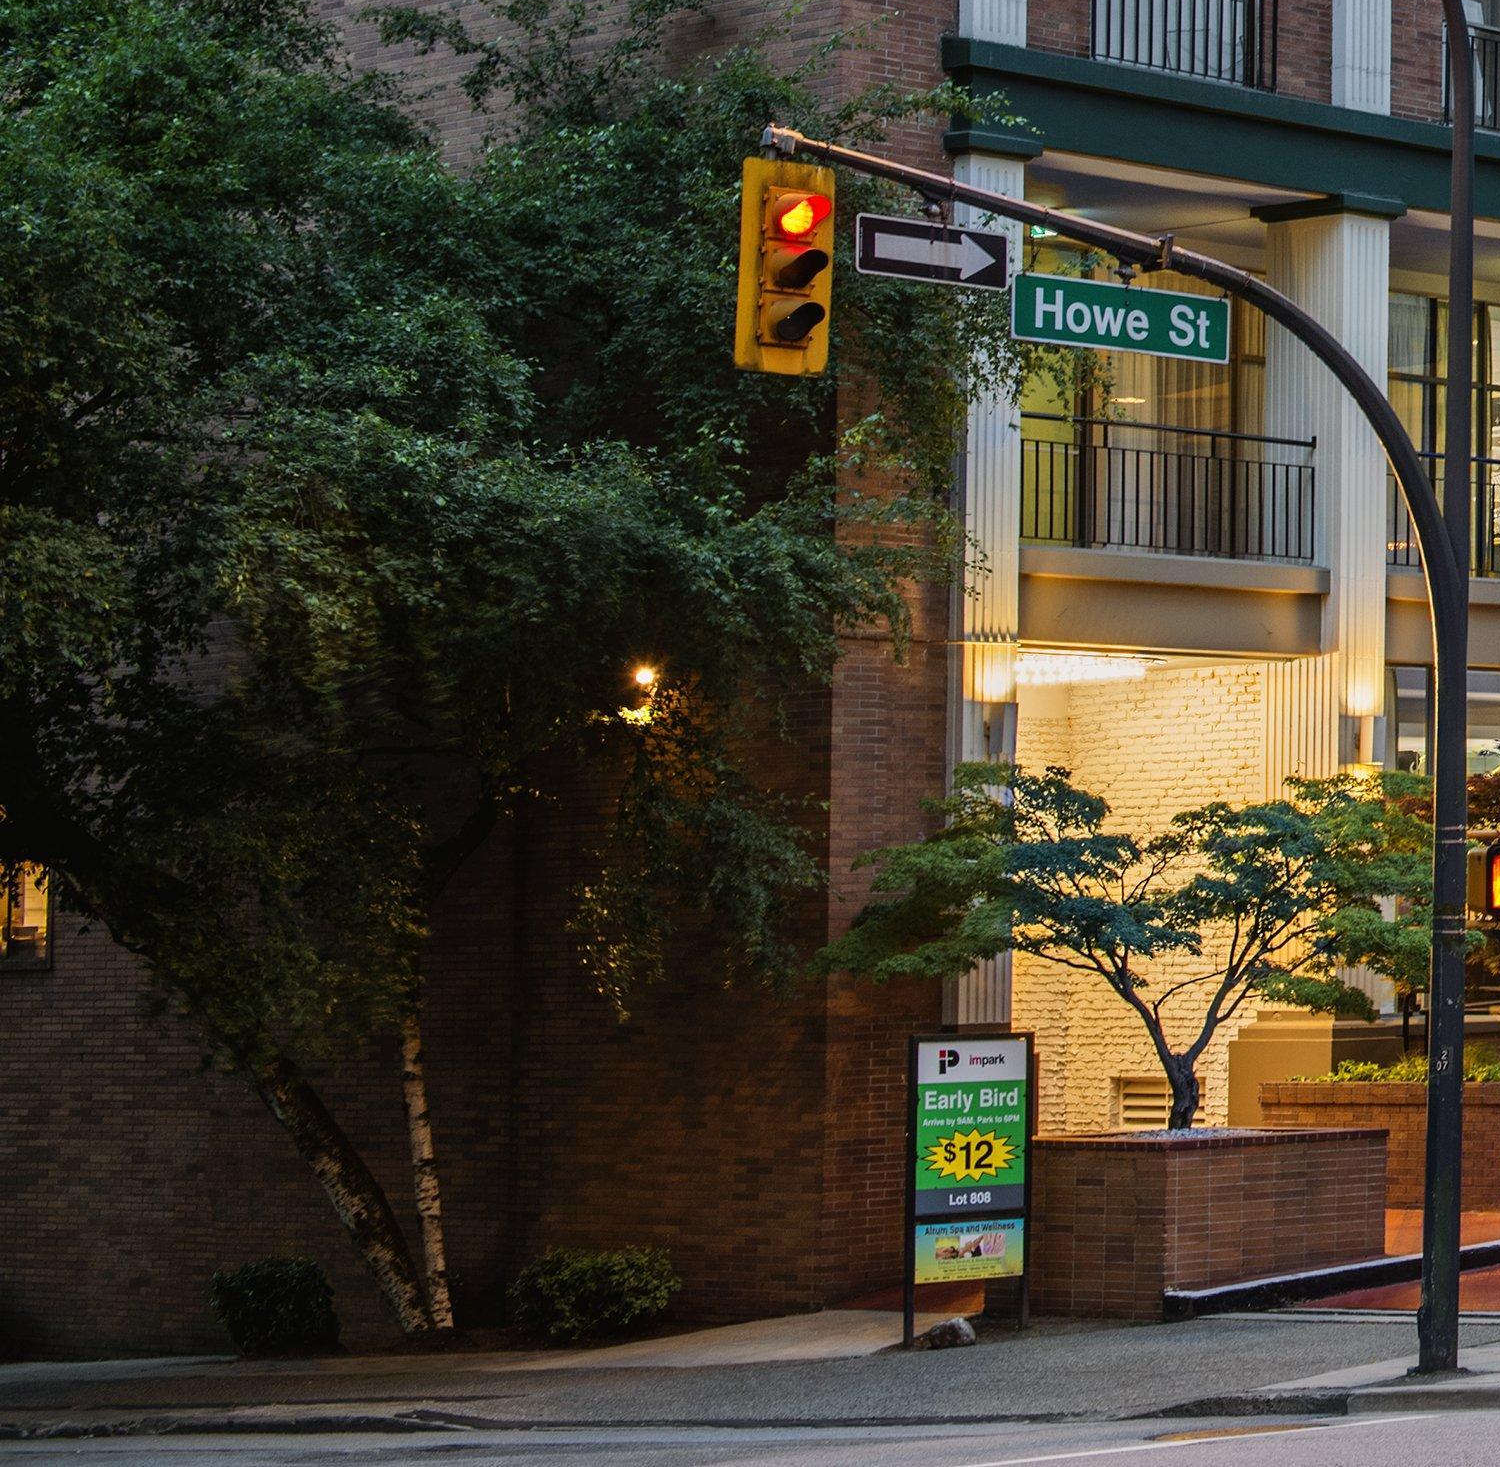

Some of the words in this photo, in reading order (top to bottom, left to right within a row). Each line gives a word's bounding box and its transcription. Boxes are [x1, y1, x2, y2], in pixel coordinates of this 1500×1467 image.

[1034, 286, 1149, 341] Howe
[1168, 303, 1210, 349] St
[969, 1054, 1006, 1068] impark
[924, 1089, 974, 1114] Early
[979, 1087, 1019, 1108] Bird
[922, 1117, 945, 1127] Arrive
[945, 1117, 956, 1127] by
[956, 1116, 976, 1126] 9AM,
[977, 1115, 994, 1124] Park
[995, 1115, 1003, 1124] to
[1003, 1114, 1020, 1123] 6PM
[943, 1140, 994, 1170] $12
[949, 1193, 968, 1206] Lot
[969, 1191, 992, 1205] 808
[949, 1225, 964, 1235] Spa
[965, 1224, 980, 1233] and
[981, 1221, 1015, 1232] Wellness
